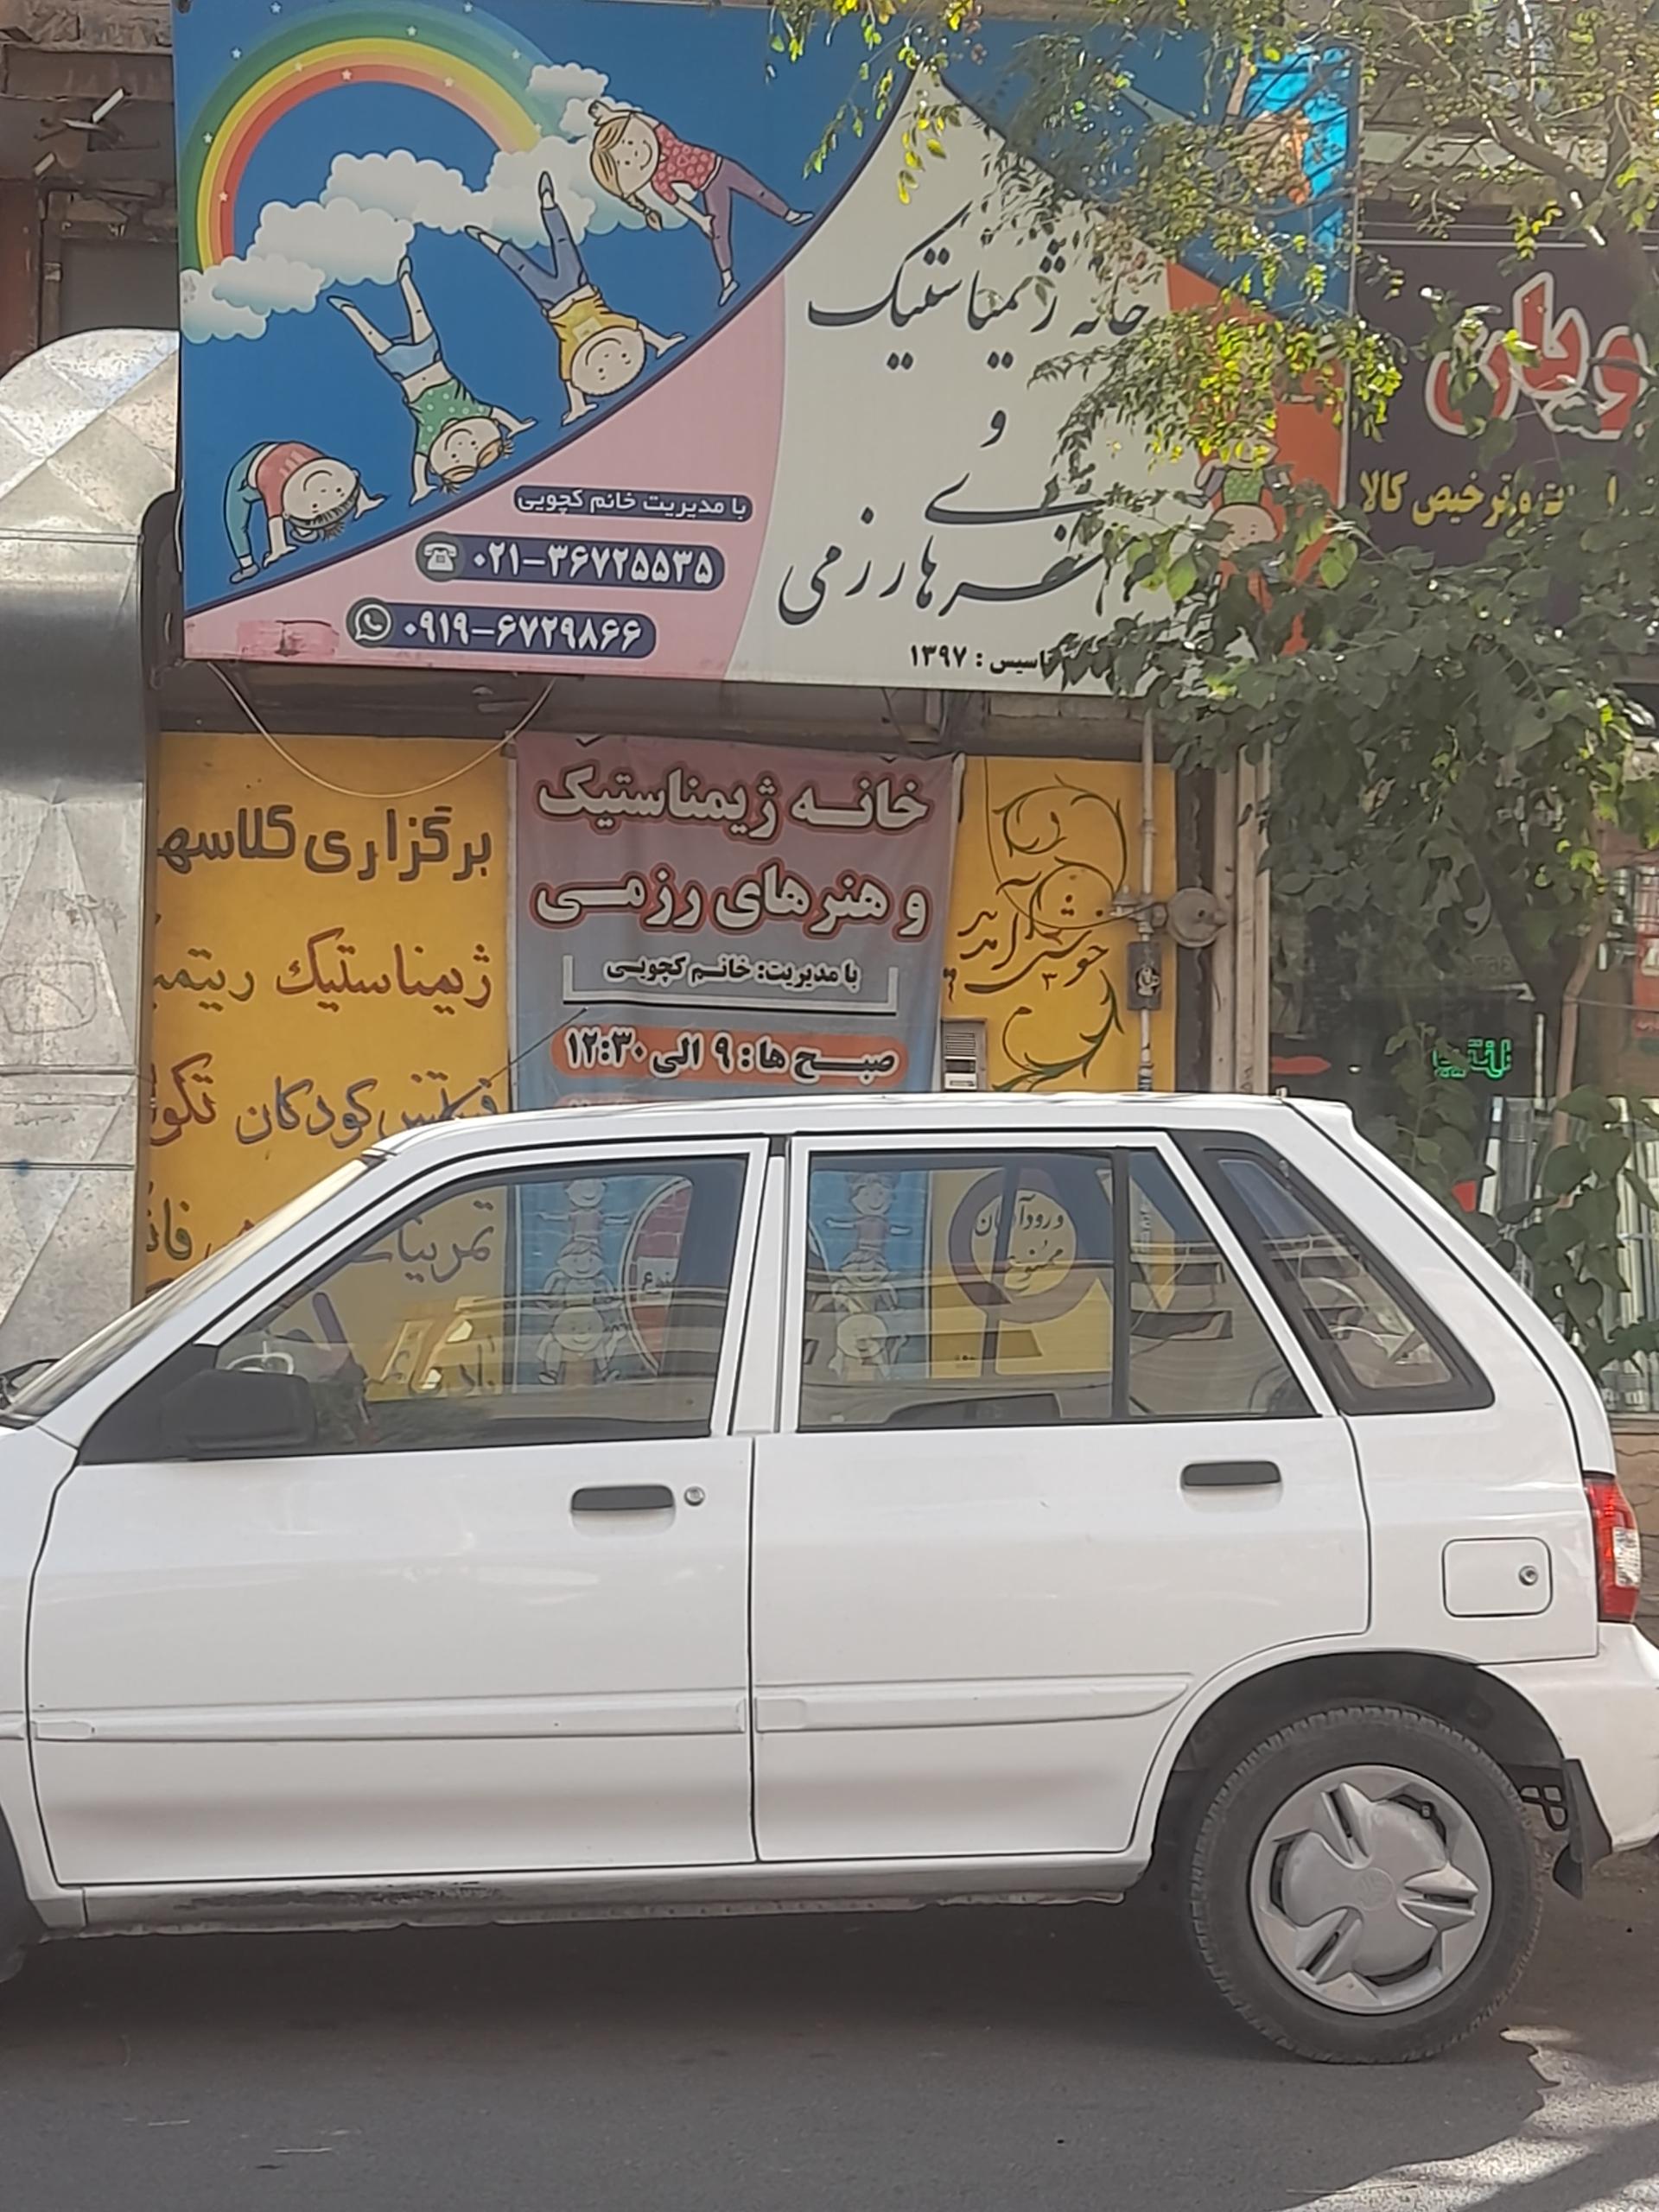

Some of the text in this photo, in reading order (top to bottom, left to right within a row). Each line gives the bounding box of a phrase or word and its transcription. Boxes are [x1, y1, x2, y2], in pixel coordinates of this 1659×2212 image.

[980, 410, 1007, 449] و
[518, 489, 747, 520] با مدیریت خانم کچویی
[1358, 469, 1408, 513] کالا
[473, 541, 714, 585] ۰۲۱-۳۶۷۲۵۵۳۵
[778, 506, 906, 626] رزمی
[404, 610, 641, 652] ۰۹۱۹-۶۷۲۹۸۶۶
[911, 645, 968, 668] ۱۳۹۷
[989, 649, 1056, 675] اسیس
[539, 767, 928, 837] خانه ژیمناستیک
[156, 804, 492, 882] برگزاری کلاسه
[537, 865, 926, 936] و هنرهای رزمی
[153, 913, 256, 1012] ریتمی
[607, 954, 858, 988] با مدیریت: خانم کچویی
[567, 1029, 645, 1066] ۱۲:۳۰
[653, 1036, 702, 1074] الی
[715, 1036, 731, 1070] ۹
[793, 1051, 895, 1082] صبح
[149, 1052, 217, 1147] تکوا
[236, 1075, 378, 1148] کودکان
